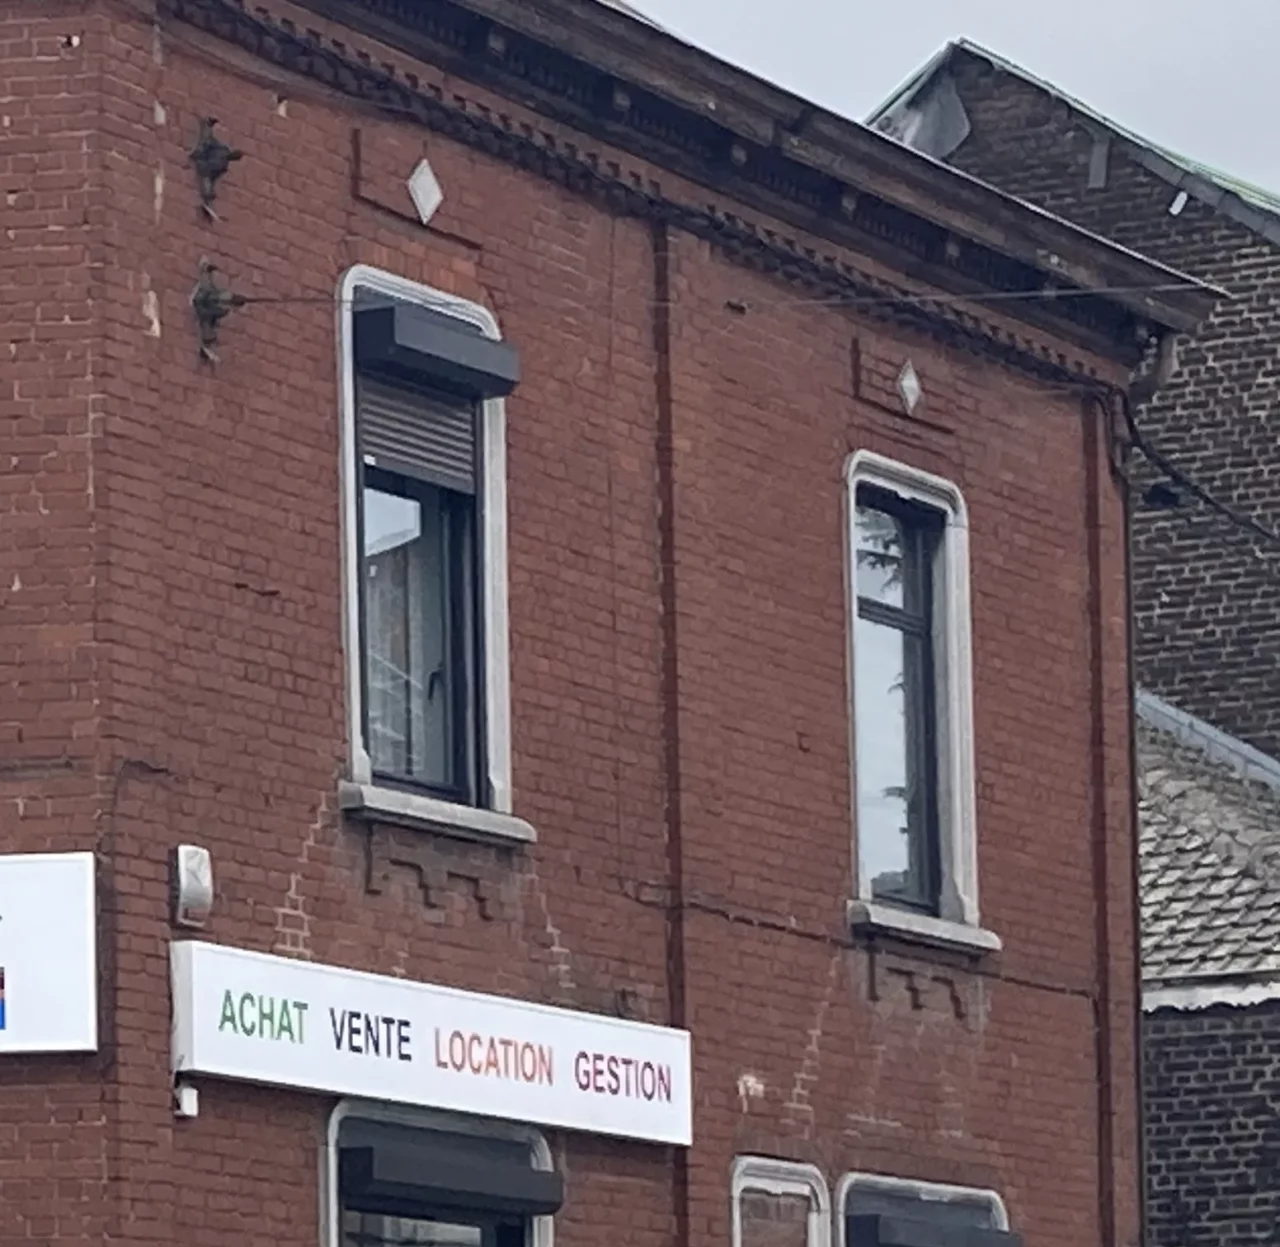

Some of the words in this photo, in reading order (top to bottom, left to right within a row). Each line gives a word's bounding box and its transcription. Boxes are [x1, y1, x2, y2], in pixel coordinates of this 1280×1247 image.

[218, 990, 309, 1043] ACHAT
[329, 1007, 413, 1062] VENTE
[435, 1029, 554, 1085] LOCATION
[574, 1051, 672, 1103] GESTION
